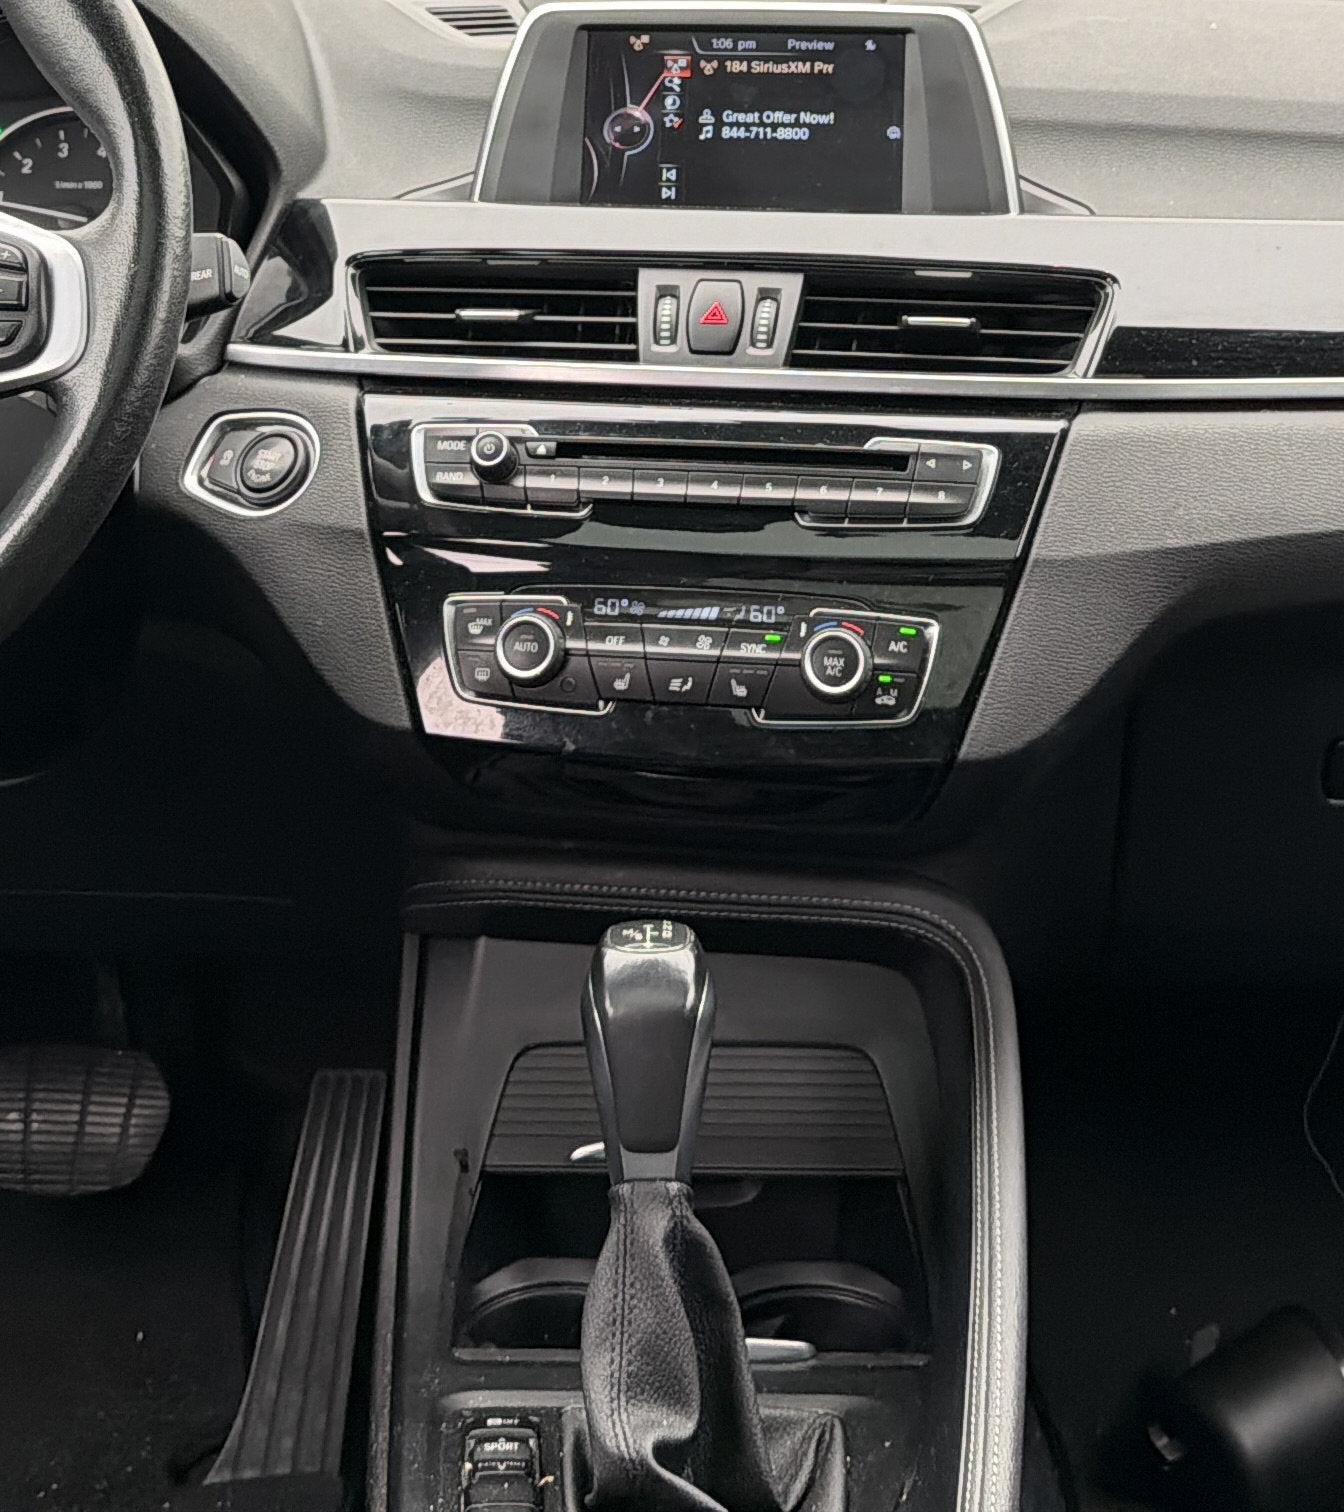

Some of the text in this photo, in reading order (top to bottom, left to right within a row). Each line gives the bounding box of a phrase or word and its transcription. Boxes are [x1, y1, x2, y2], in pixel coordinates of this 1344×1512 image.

[711, 38, 836, 52] 1:06 pm Preview
[724, 60, 748, 74] 184
[750, 60, 811, 75] SiriusXM
[722, 109, 835, 125] Great Offer Now!
[721, 126, 810, 141] 844-711-8800
[57, 142, 69, 159] 3
[21, 157, 34, 174] 2
[436, 439, 468, 451] MODE
[435, 471, 464, 482] BAND
[601, 475, 610, 486] 2
[657, 477, 665, 488] 3
[710, 479, 719, 490] 4
[765, 481, 773, 493] 5
[819, 484, 828, 495] 6
[876, 486, 884, 497] 7
[937, 490, 946, 501] 8
[513, 640, 539, 653] AUTO
[605, 635, 626, 646] OFF
[888, 640, 908, 653] A/C
[740, 642, 767, 655] SYNC
[823, 655, 845, 667] MAX
[825, 666, 843, 677] A/C
